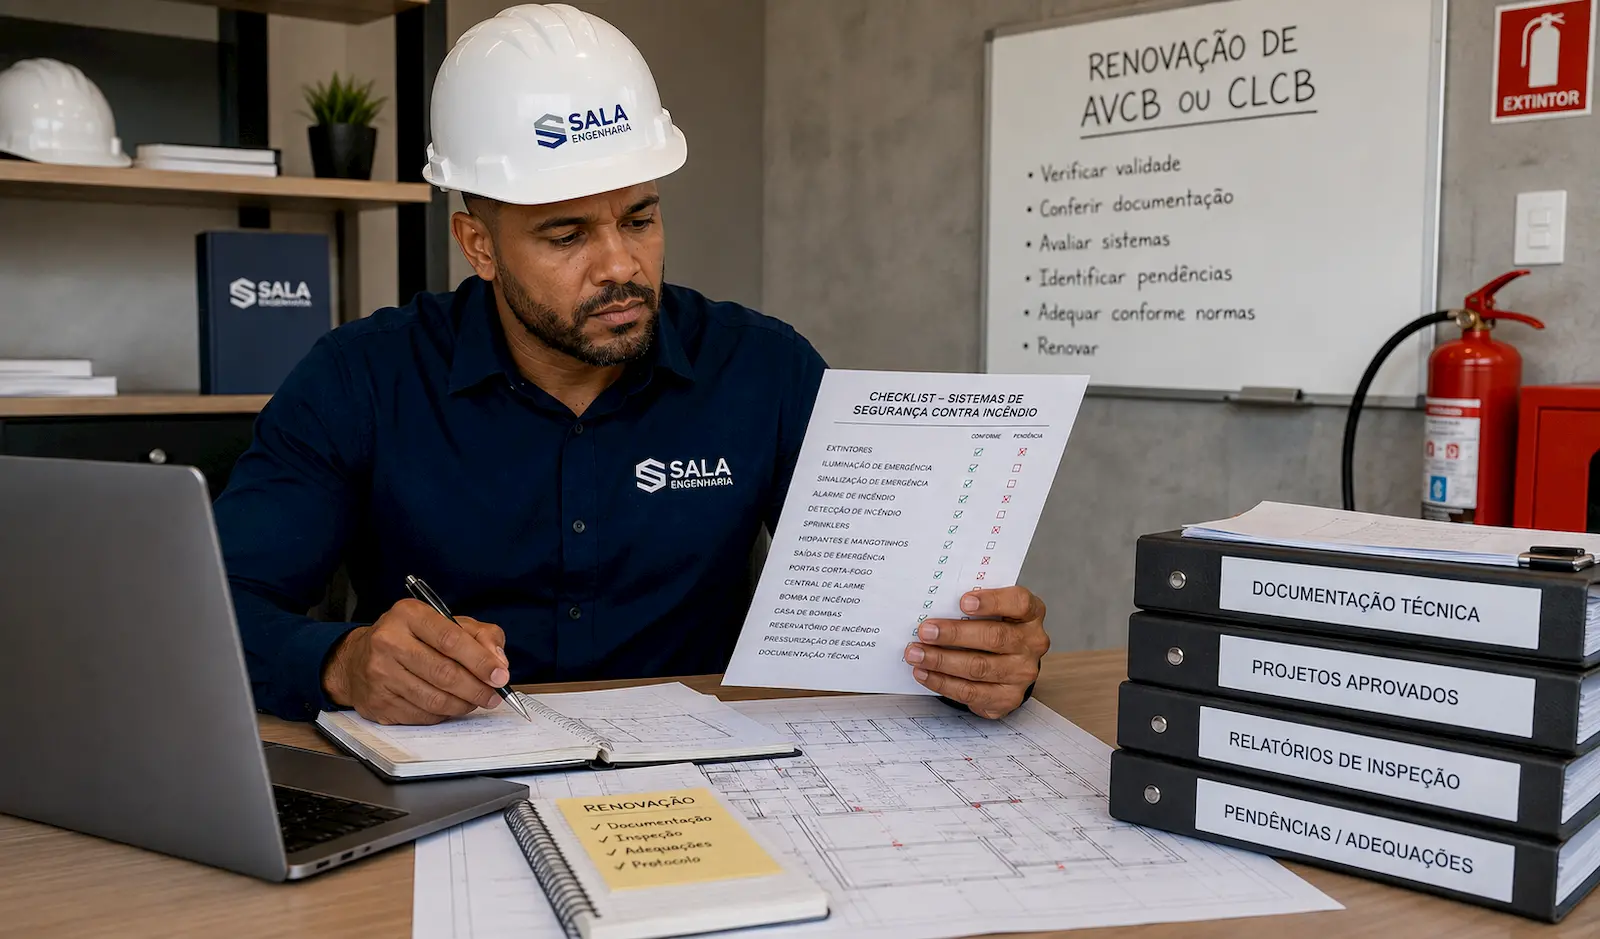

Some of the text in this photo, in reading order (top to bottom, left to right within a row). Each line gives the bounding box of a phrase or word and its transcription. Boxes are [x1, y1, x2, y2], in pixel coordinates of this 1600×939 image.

[1089, 25, 1299, 81] RENOVAÇÃO DE
[1080, 88, 1162, 128] AVCB
[1228, 69, 1316, 108] CLCB
[1502, 90, 1580, 111] EXTINTOR
[568, 104, 629, 132] SALA
[572, 123, 632, 144] ENGENHARIA
[1040, 155, 1181, 183] Verificar validade
[1039, 189, 1235, 218] Conferir documentação
[1039, 232, 1171, 252] Avaliar sistemas
[1039, 266, 1233, 291] Identificar pendências
[258, 280, 312, 300] SALA
[1038, 304, 1255, 327] Adequar conforme normas
[1037, 337, 1099, 357] Renovar
[869, 391, 936, 403] CHECKLIST
[947, 393, 1005, 404] SISTEMAS
[1007, 394, 1024, 404] DE
[853, 405, 1038, 419] SEGURANÇA CONTRA INCÊNDIO
[826, 444, 873, 454] EXTINTORES
[669, 457, 732, 479] SALA
[670, 477, 734, 489] ENGENHARIA
[812, 490, 845, 499] ALARME
[845, 492, 857, 500] DE
[803, 520, 850, 530] SPRINKLERS
[844, 537, 849, 545] E
[850, 538, 909, 548] MANGOTINHOS
[793, 549, 822, 558] SAÍDAS
[788, 564, 873, 576] PORTAS CORTA-FOGO
[784, 579, 820, 588] CENTRAL
[833, 582, 865, 590] ALARME
[779, 593, 808, 602] BOMBA
[1252, 580, 1480, 623] DOCUMENTAÇÃO TÉCNICA
[774, 607, 795, 615] CASA
[808, 610, 842, 618] BOMBAS
[840, 640, 876, 648] ESCADAS
[827, 651, 860, 660] TÉCNICA
[1251, 659, 1459, 706] PROJETOS APROVADOS
[1229, 731, 1461, 790] RELATÓRIOS DE INSPEÇÃO
[583, 796, 696, 813] RENOVAÇÃO
[606, 815, 712, 830] Documentação
[614, 830, 683, 843] Inspeção
[1224, 804, 1474, 876] PENDÊNCIAS / ADEQUAÇÕES
[625, 839, 713, 855] Adequações
